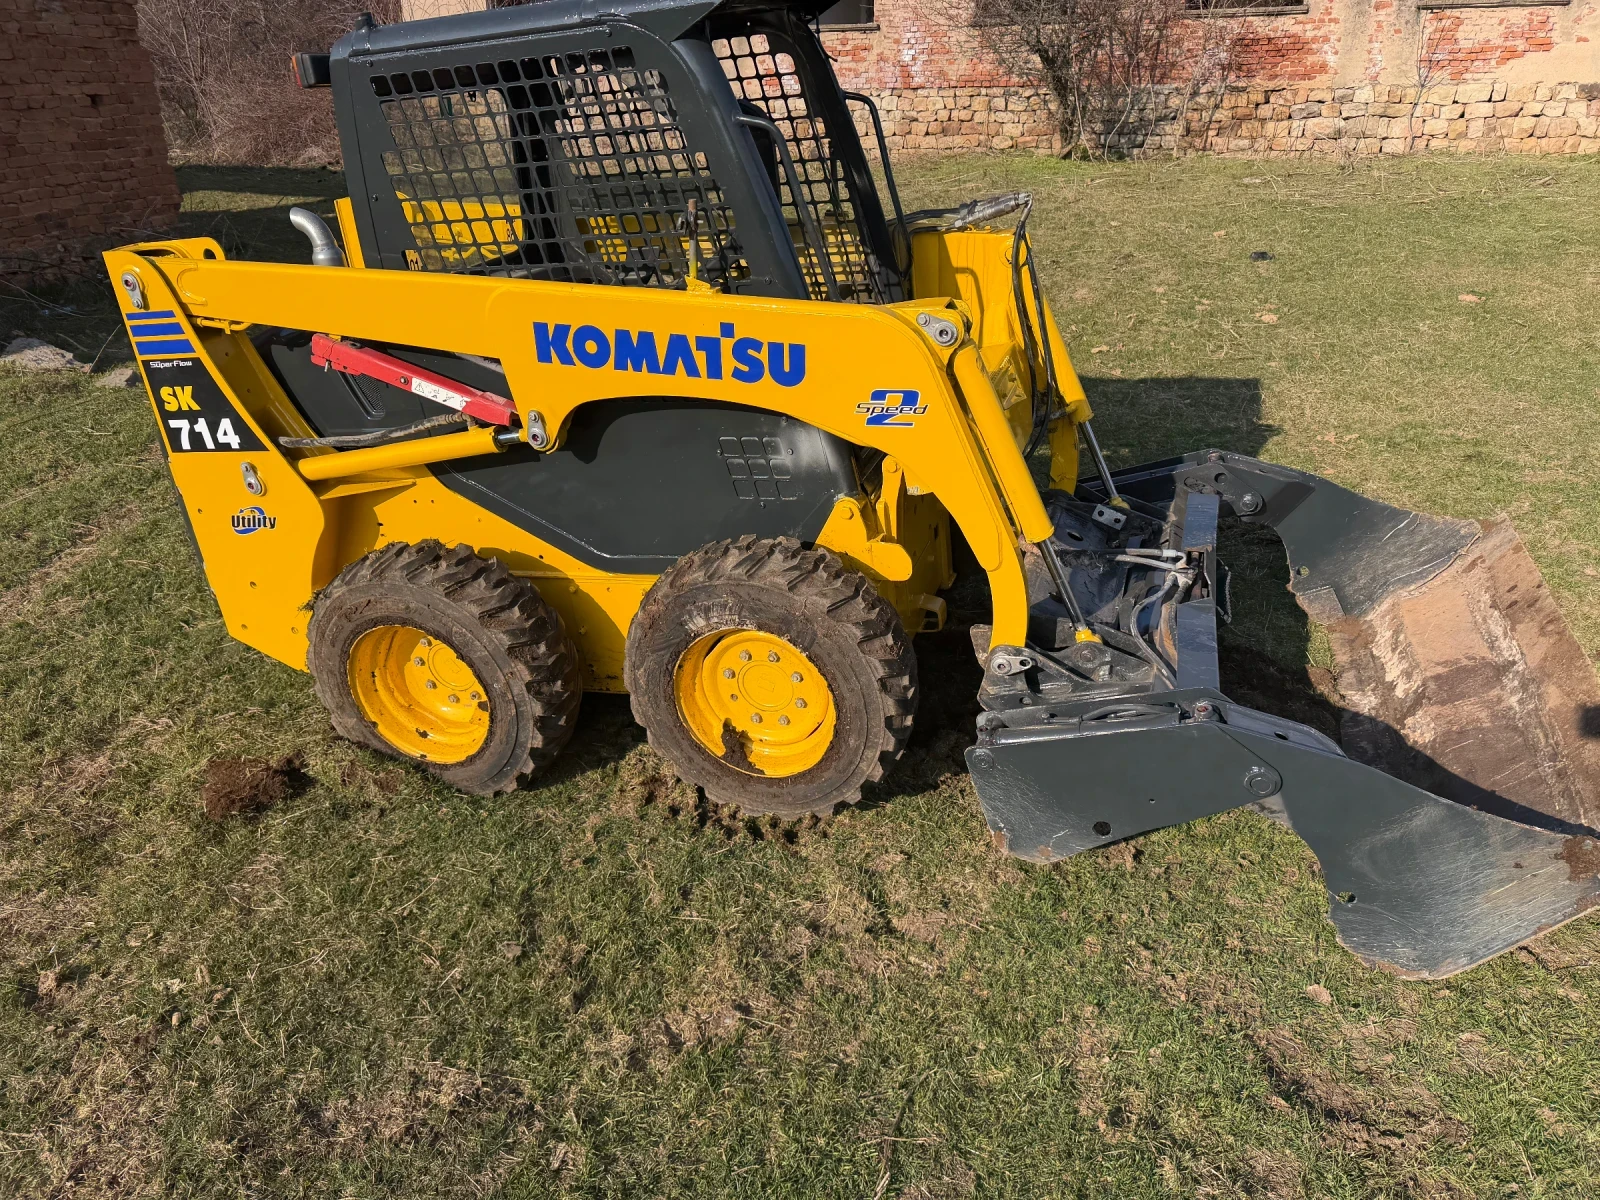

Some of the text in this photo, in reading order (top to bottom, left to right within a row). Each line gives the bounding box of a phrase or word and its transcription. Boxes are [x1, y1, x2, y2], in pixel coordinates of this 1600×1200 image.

[532, 321, 806, 387] KOMATSU
[160, 386, 201, 412] SK
[854, 389, 929, 427] 2 Speed
[167, 418, 241, 450] 714
[231, 514, 277, 530] Utility
